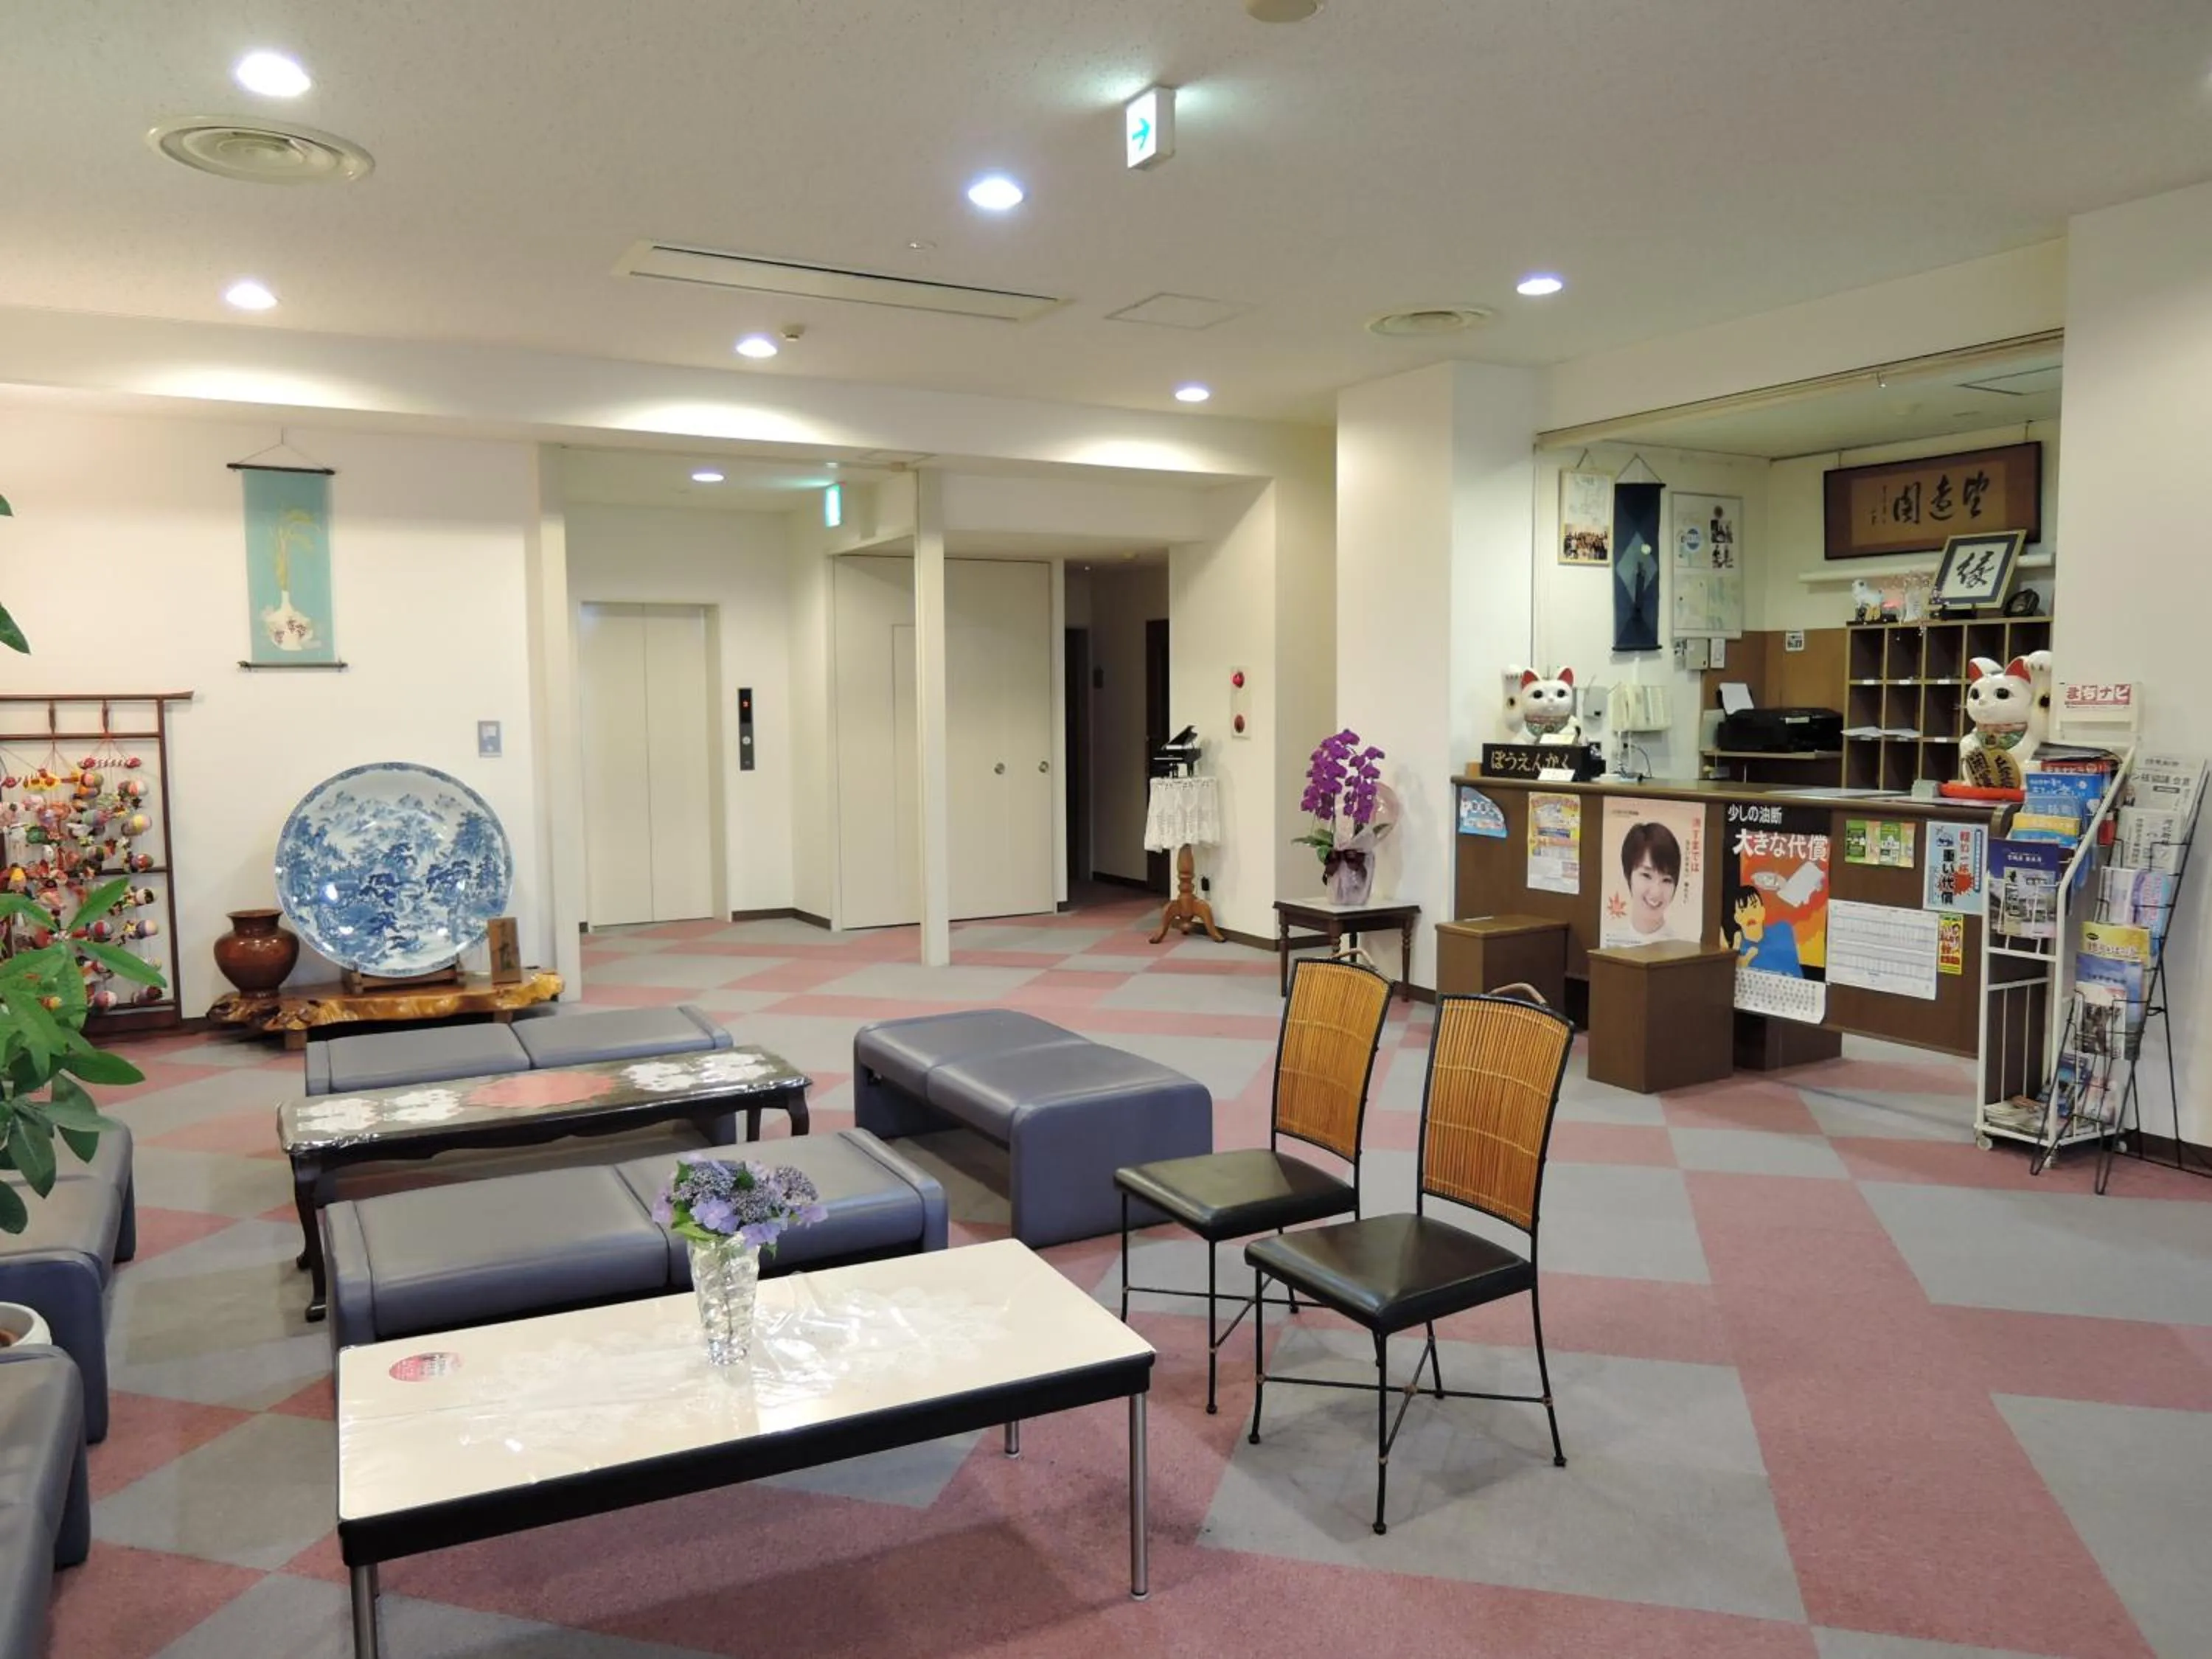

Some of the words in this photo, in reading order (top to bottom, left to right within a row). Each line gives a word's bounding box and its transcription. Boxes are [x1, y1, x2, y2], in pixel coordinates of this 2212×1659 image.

[1728, 803, 1783, 825] 少しの油断
[1731, 827, 1829, 863] 大きな代償
